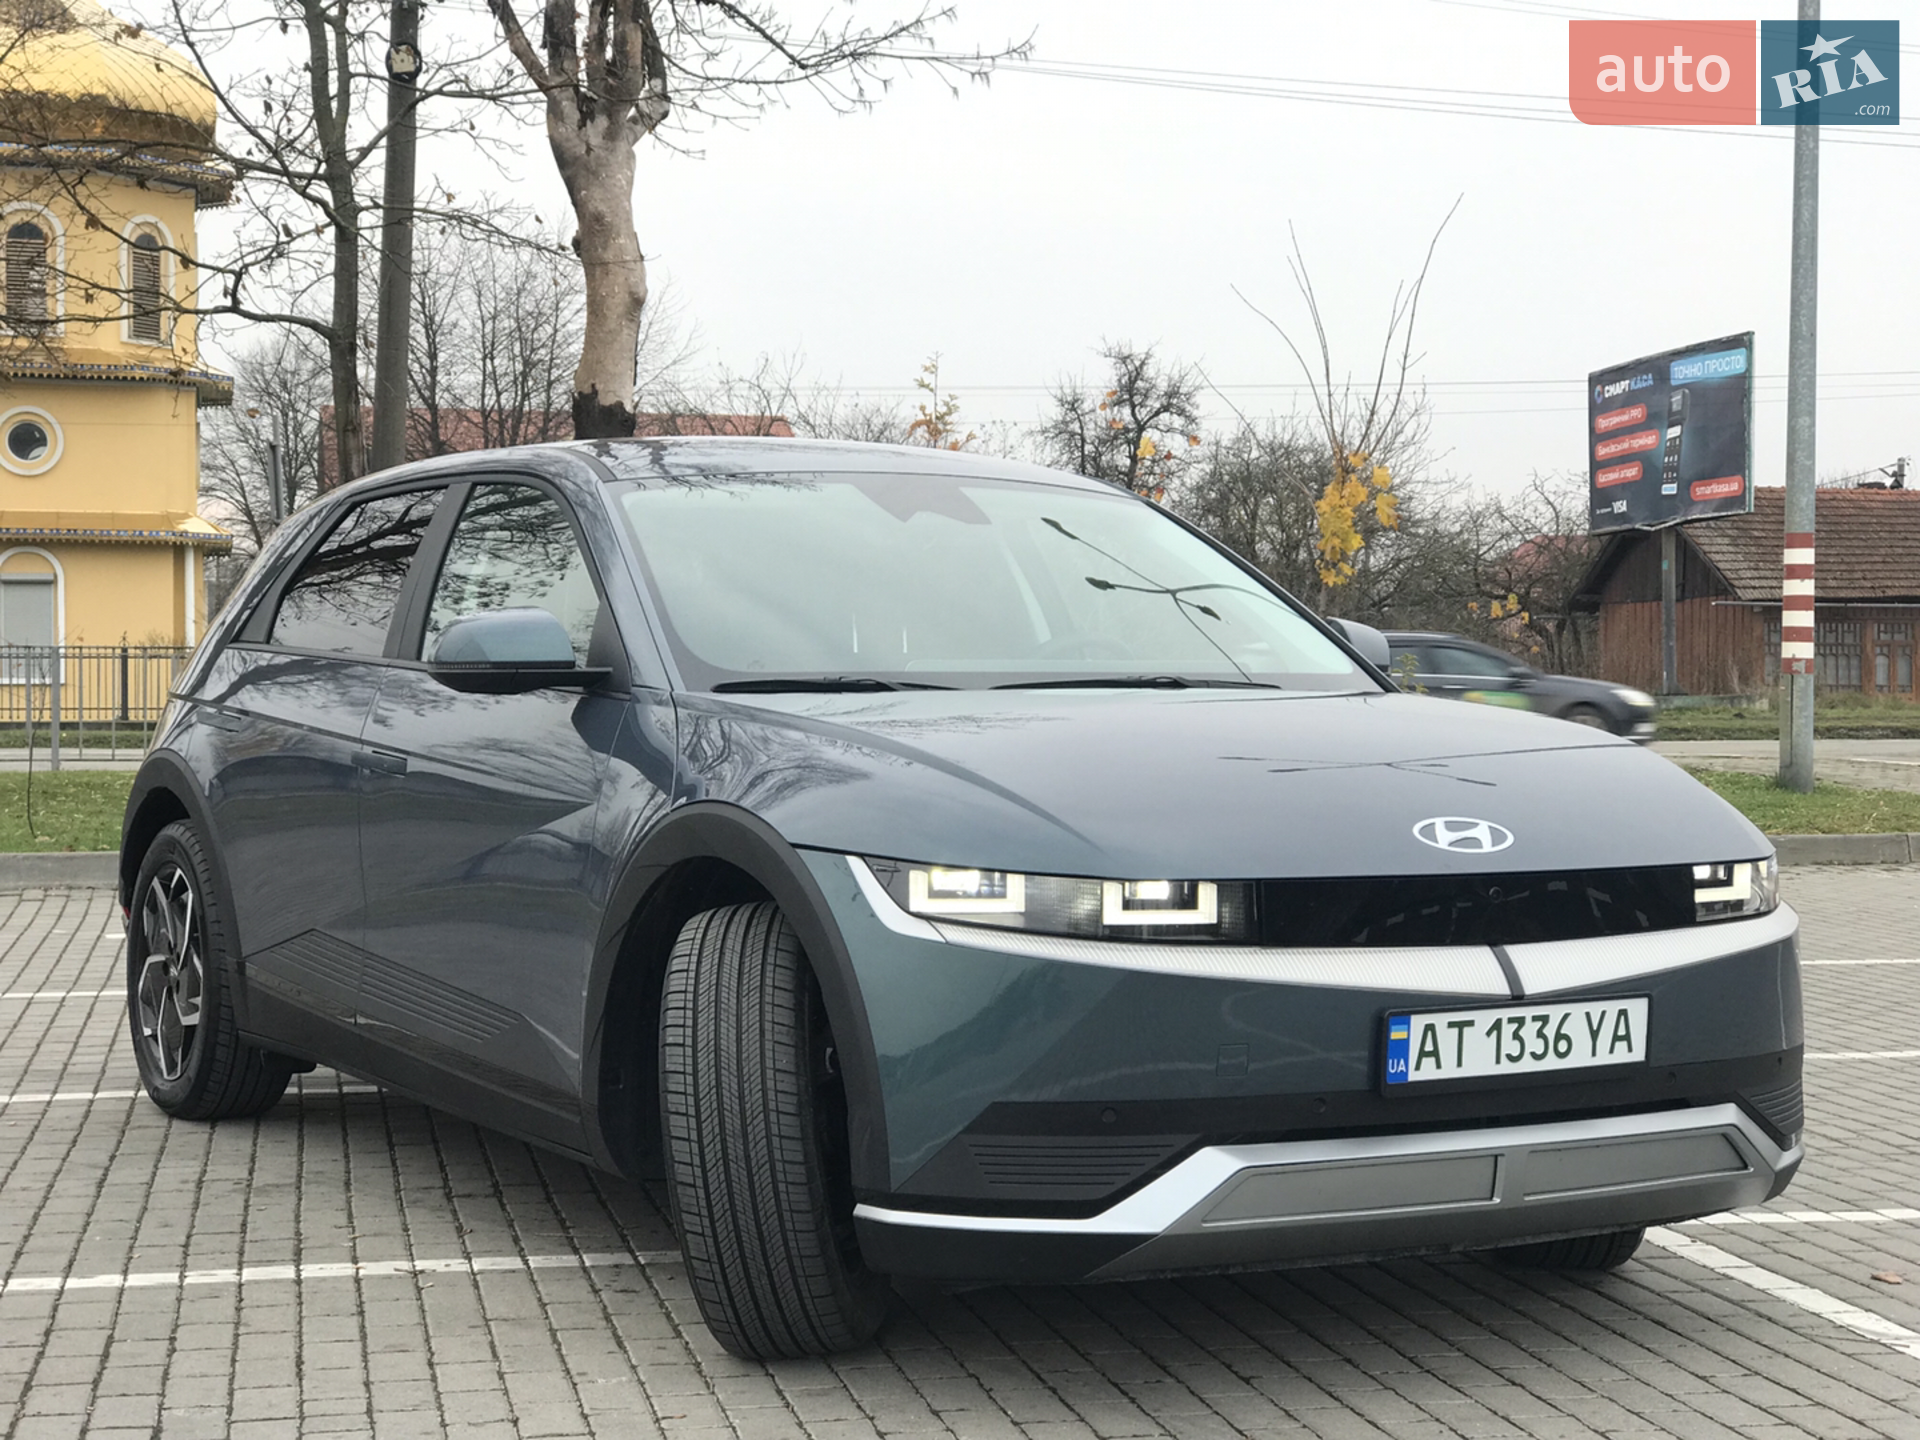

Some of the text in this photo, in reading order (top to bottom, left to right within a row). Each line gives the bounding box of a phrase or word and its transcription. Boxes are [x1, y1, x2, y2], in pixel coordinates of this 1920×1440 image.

[1673, 355, 1744, 379] ТОЧНО ПРОСТО!
[1604, 373, 1654, 398] СМАРТ КАСА
[1695, 482, 1739, 496] smartkasa.ua
[1612, 499, 1628, 514] VISA
[1414, 1008, 1634, 1071] AT 1336 YA
[1388, 1058, 1407, 1074] UA
